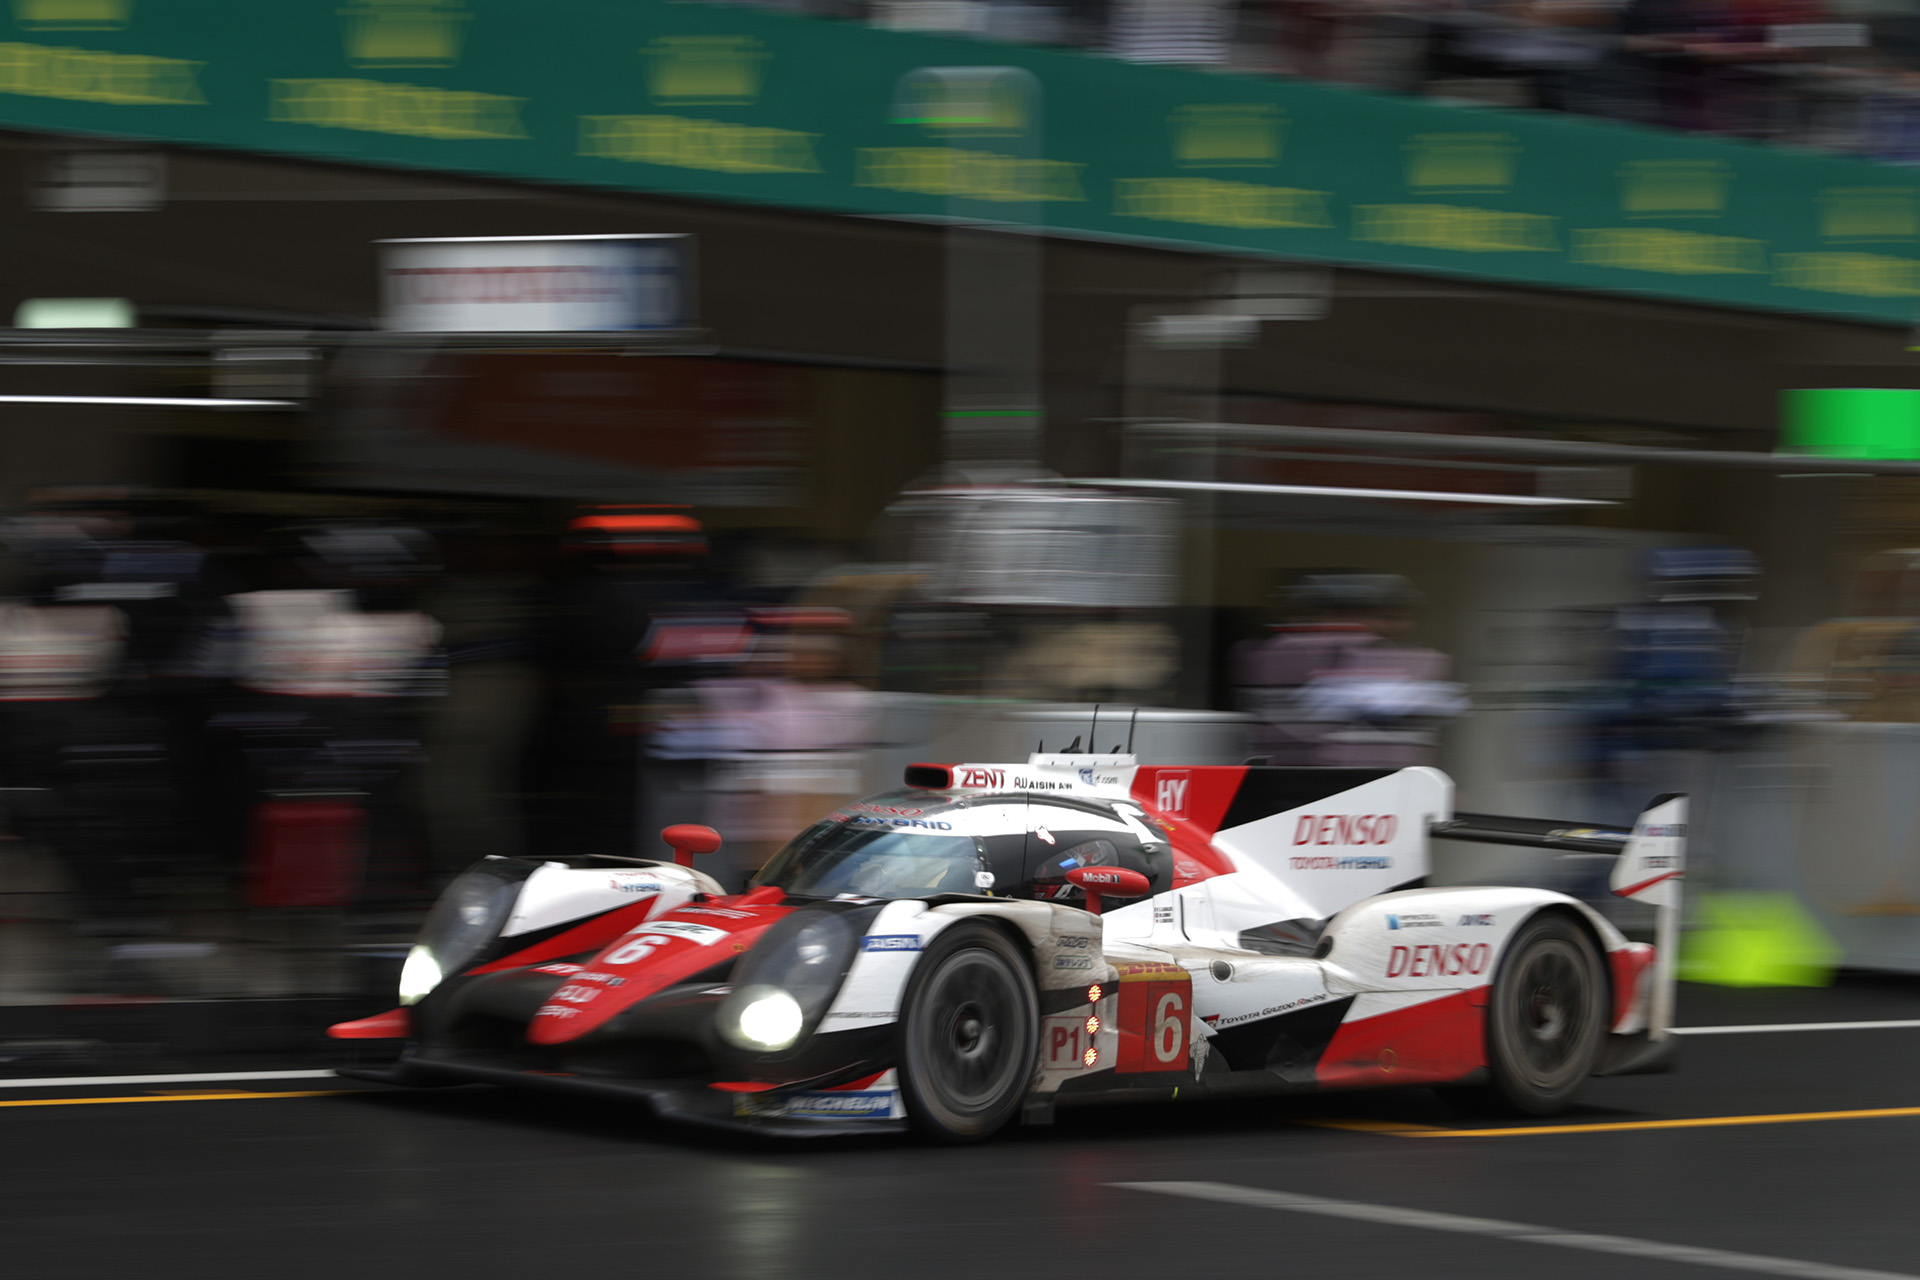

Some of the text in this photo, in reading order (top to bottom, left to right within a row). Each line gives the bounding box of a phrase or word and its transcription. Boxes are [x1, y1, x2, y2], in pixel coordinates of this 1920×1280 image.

[960, 768, 1005, 789] ZENT
[1029, 781, 1056, 790] AISIN
[1158, 779, 1189, 812] HY
[853, 817, 953, 831] HYBRID
[1292, 814, 1399, 846] DENSO
[1082, 872, 1111, 883] Mobil
[602, 935, 672, 964] 6
[865, 937, 919, 950] AISIN
[1056, 935, 1088, 948] RAYS
[1385, 942, 1493, 978] DENSO
[1220, 1011, 1260, 1025] TOYOTA
[1262, 1002, 1296, 1016] GAZOO
[1154, 992, 1183, 1063] 6
[1051, 1026, 1079, 1061] P1
[786, 1096, 886, 1111] MICHELIN
